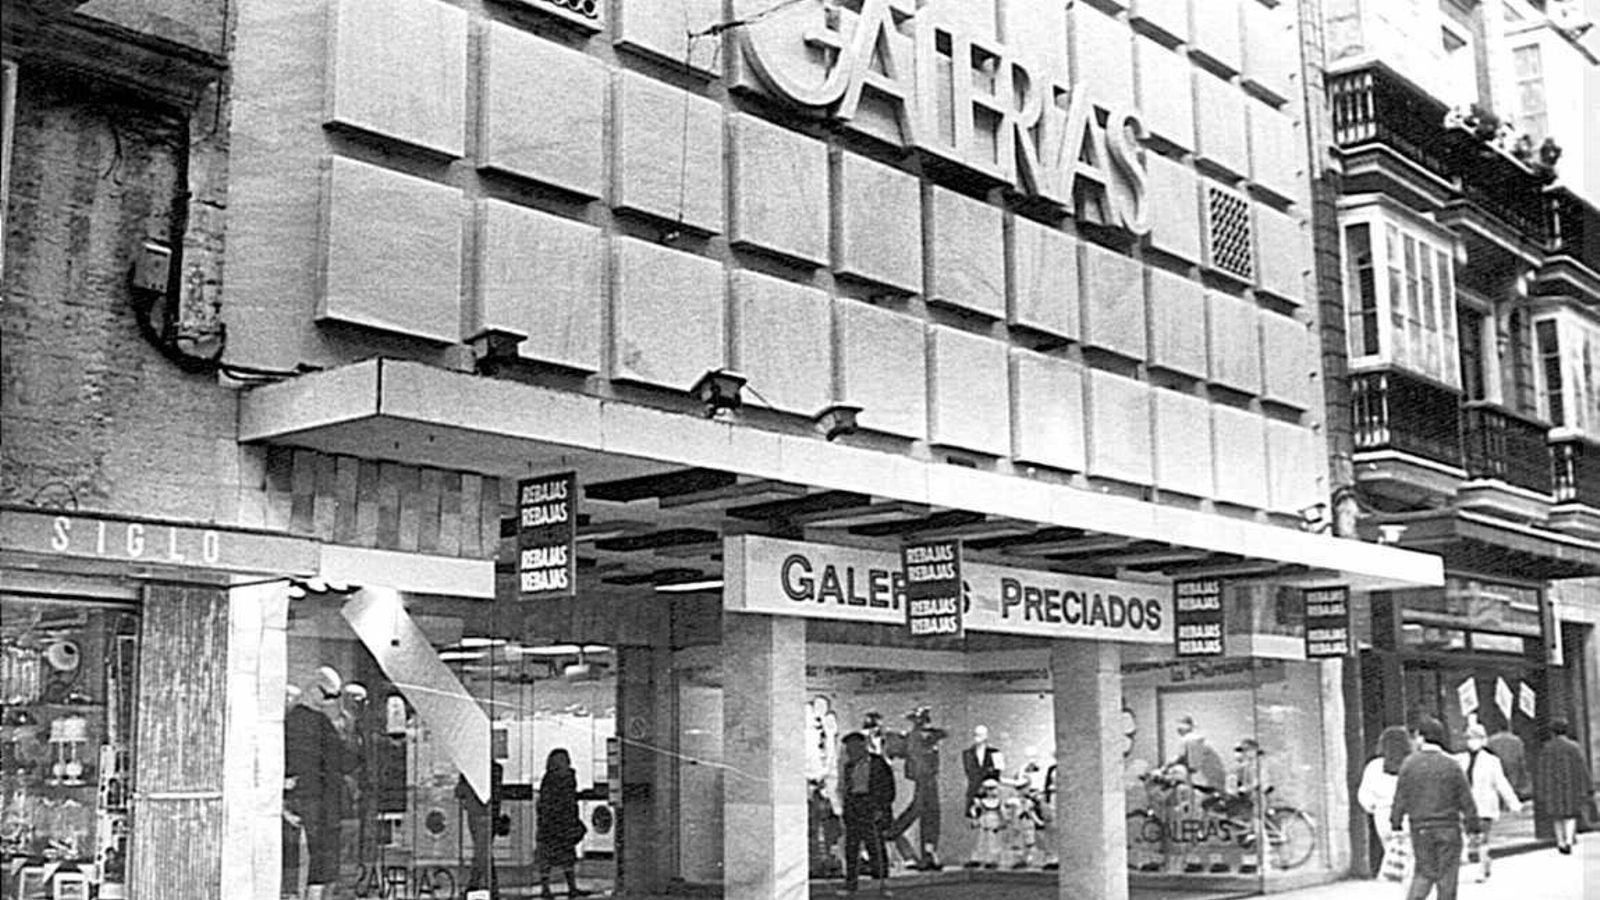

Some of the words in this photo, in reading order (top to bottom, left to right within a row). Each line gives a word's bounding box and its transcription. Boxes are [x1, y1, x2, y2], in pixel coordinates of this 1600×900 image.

[522, 480, 567, 505] REBAJAS
[522, 502, 567, 527] REBAJAS
[52, 516, 219, 563] SIGLO
[521, 545, 568, 570] REBAJAS
[906, 545, 955, 564] REBAJAS
[521, 567, 568, 592] REBAJAS
[908, 563, 956, 582] REBAJAS
[911, 598, 957, 617] REBAJAS
[1001, 577, 1162, 631] PRECIADOS
[912, 615, 957, 635] REBAJAS
